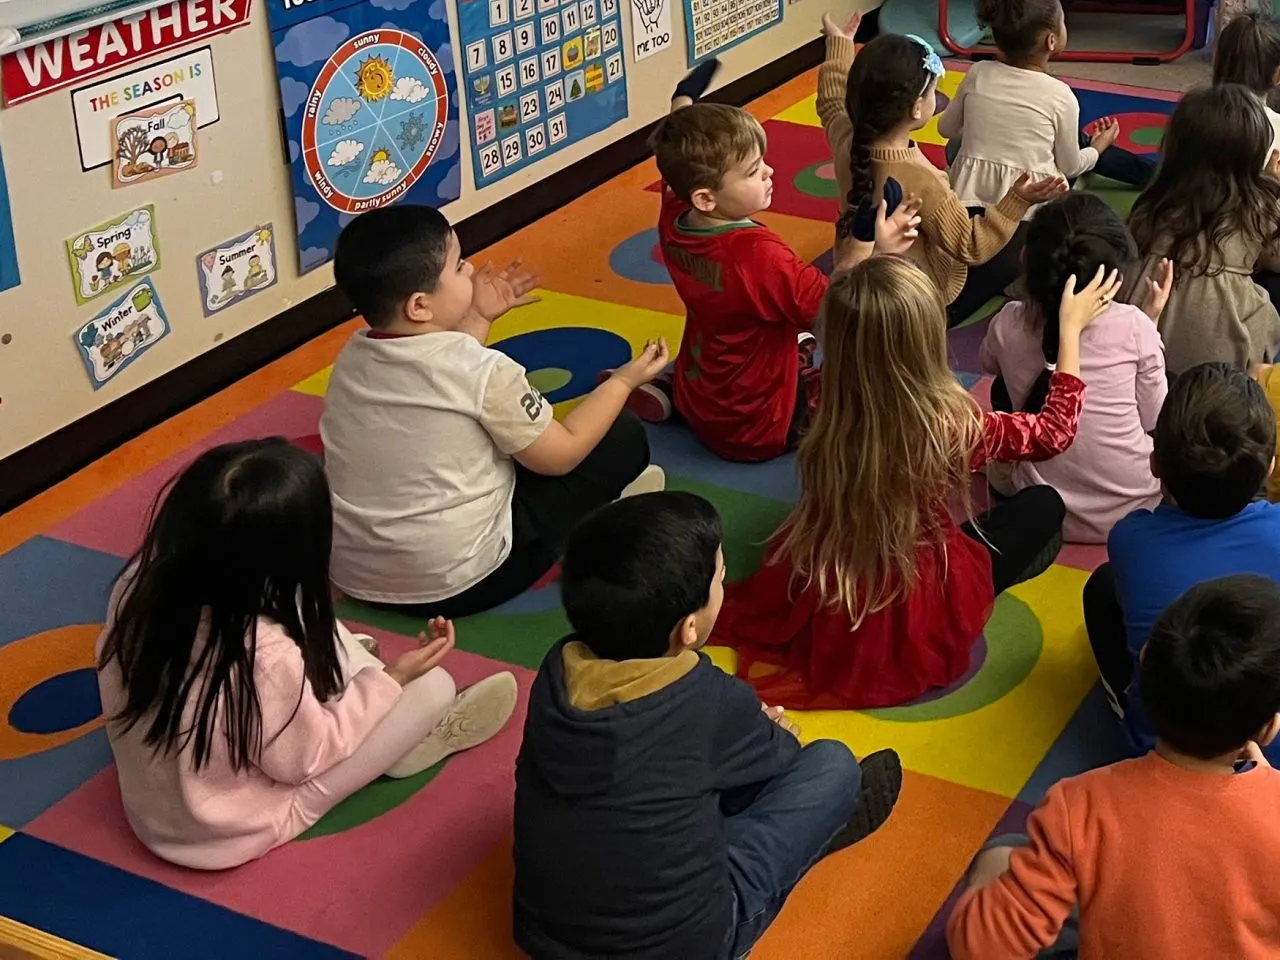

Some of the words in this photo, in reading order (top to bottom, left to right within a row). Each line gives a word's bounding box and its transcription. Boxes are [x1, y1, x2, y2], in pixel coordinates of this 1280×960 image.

[496, 4, 501, 20] 1
[353, 33, 380, 49] sunny
[473, 48, 480, 64] 7
[499, 40, 506, 55] 8
[521, 30, 528, 45] 9
[545, 21, 557, 37] 10
[567, 10, 575, 26] 11
[584, 5, 594, 21] 12
[637, 41, 650, 56] ME
[652, 33, 670, 49] TOO
[417, 47, 439, 76] cloudy
[500, 72, 513, 90] 15
[523, 63, 536, 80] 16
[546, 54, 556, 71] 17
[605, 28, 616, 44] 20
[90, 91, 119, 112] THE
[124, 69, 184, 102] SEASON
[188, 63, 201, 79] IS
[524, 99, 537, 116] 23
[549, 87, 562, 105] 24
[609, 59, 620, 76] 27
[308, 89, 321, 118] rainy
[147, 118, 165, 132] Fall
[426, 121, 443, 157] snowy
[484, 149, 499, 169] 28
[506, 141, 519, 160] 29
[529, 131, 543, 148] 30
[552, 120, 564, 137] 31
[314, 170, 333, 199] windy
[354, 197, 381, 211] partly
[381, 180, 407, 202] sunny
[97, 227, 131, 249] Spring
[218, 244, 256, 265] Summer
[101, 305, 133, 332] Winter
